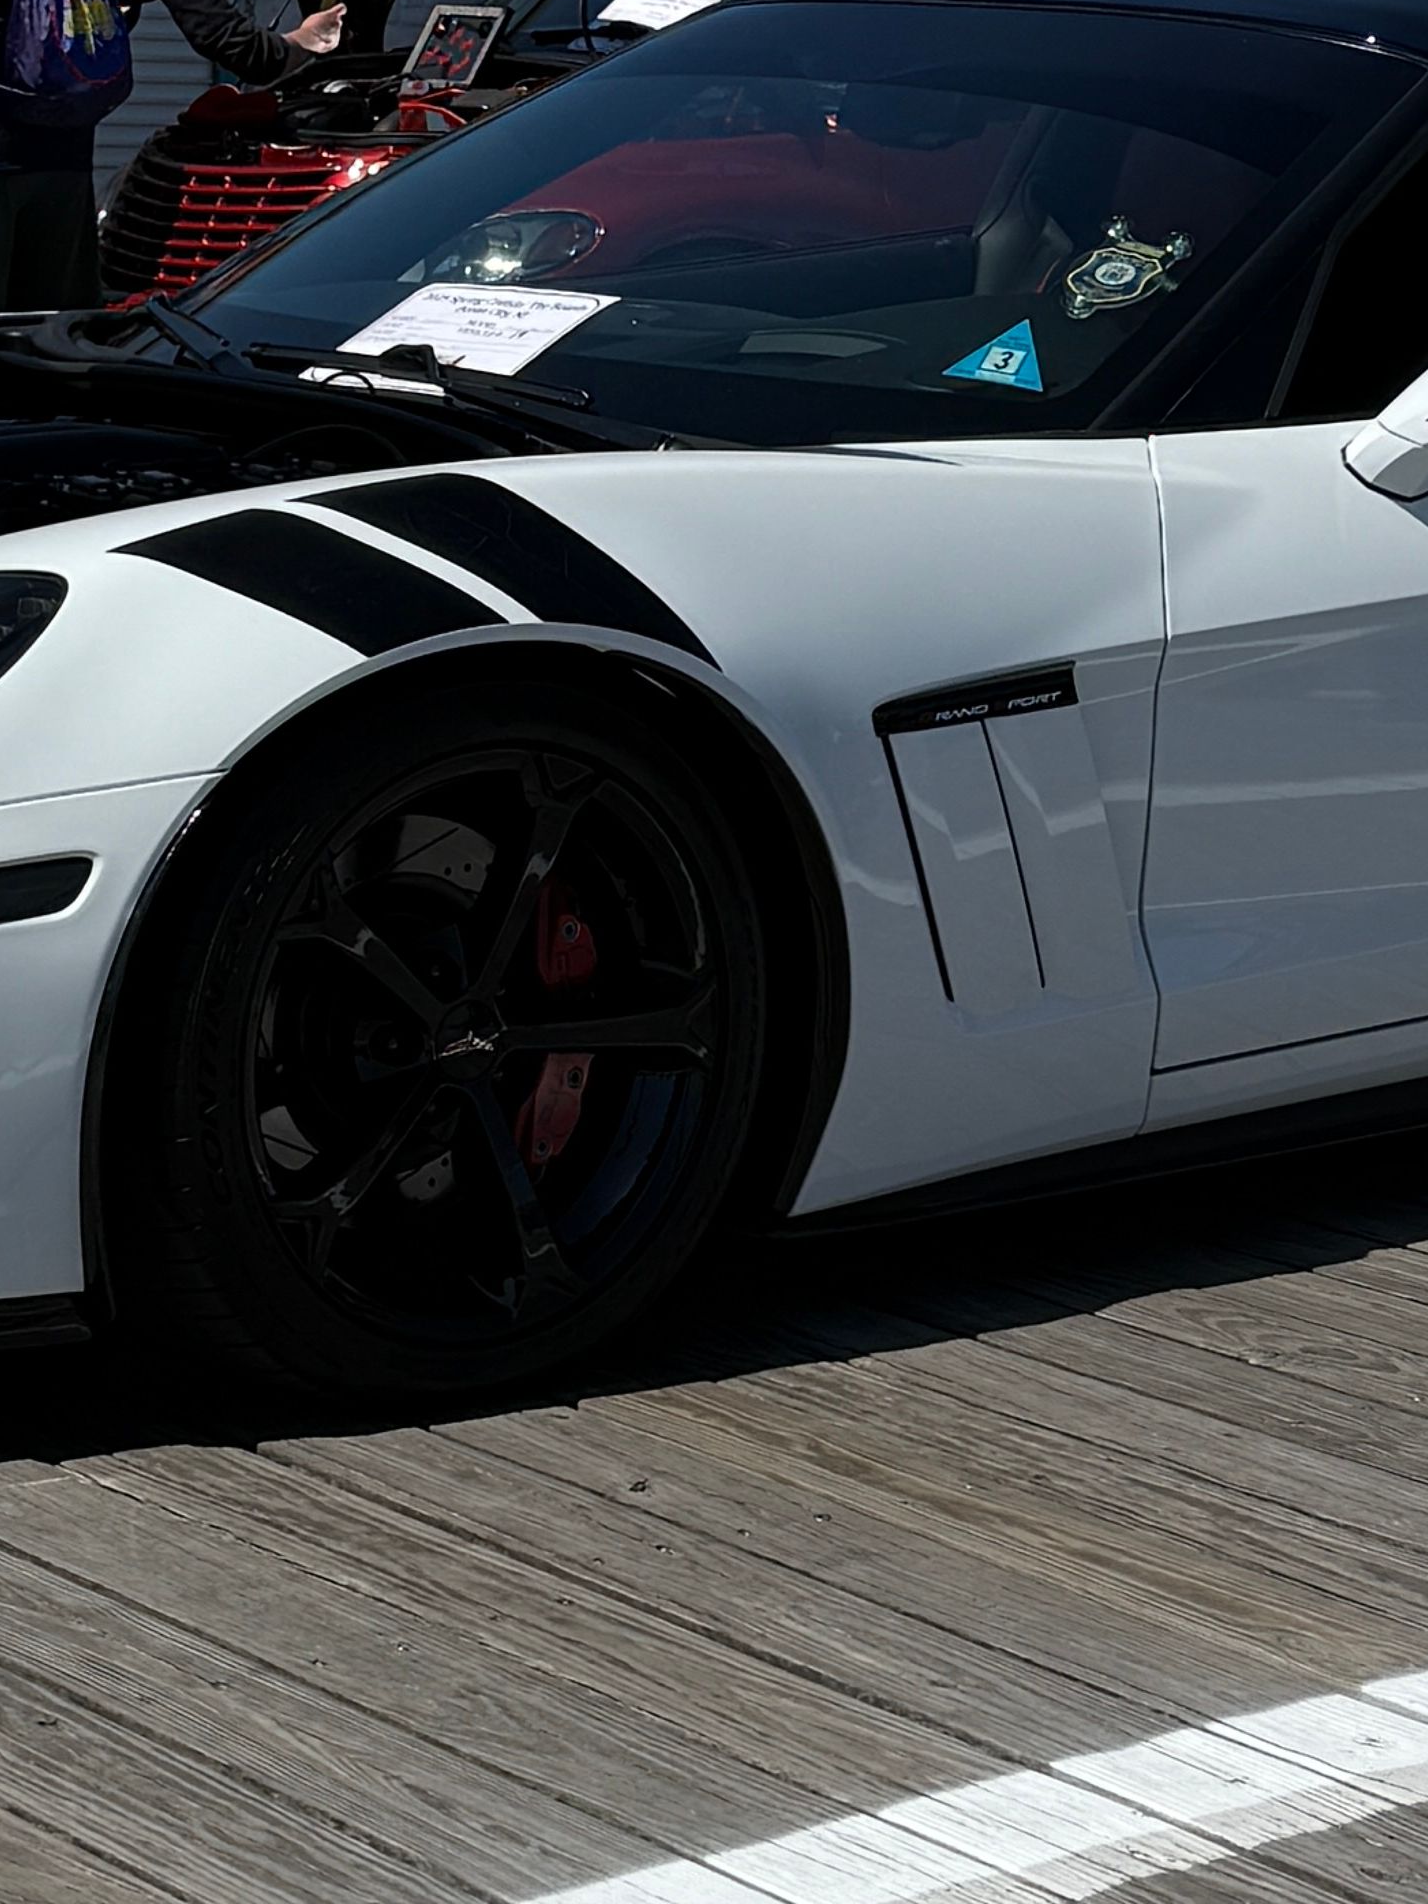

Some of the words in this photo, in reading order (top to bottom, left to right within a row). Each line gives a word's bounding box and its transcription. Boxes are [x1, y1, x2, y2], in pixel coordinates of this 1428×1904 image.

[994, 351, 1014, 370] 3
[918, 702, 990, 723] RAND
[993, 690, 1063, 714] PORT
